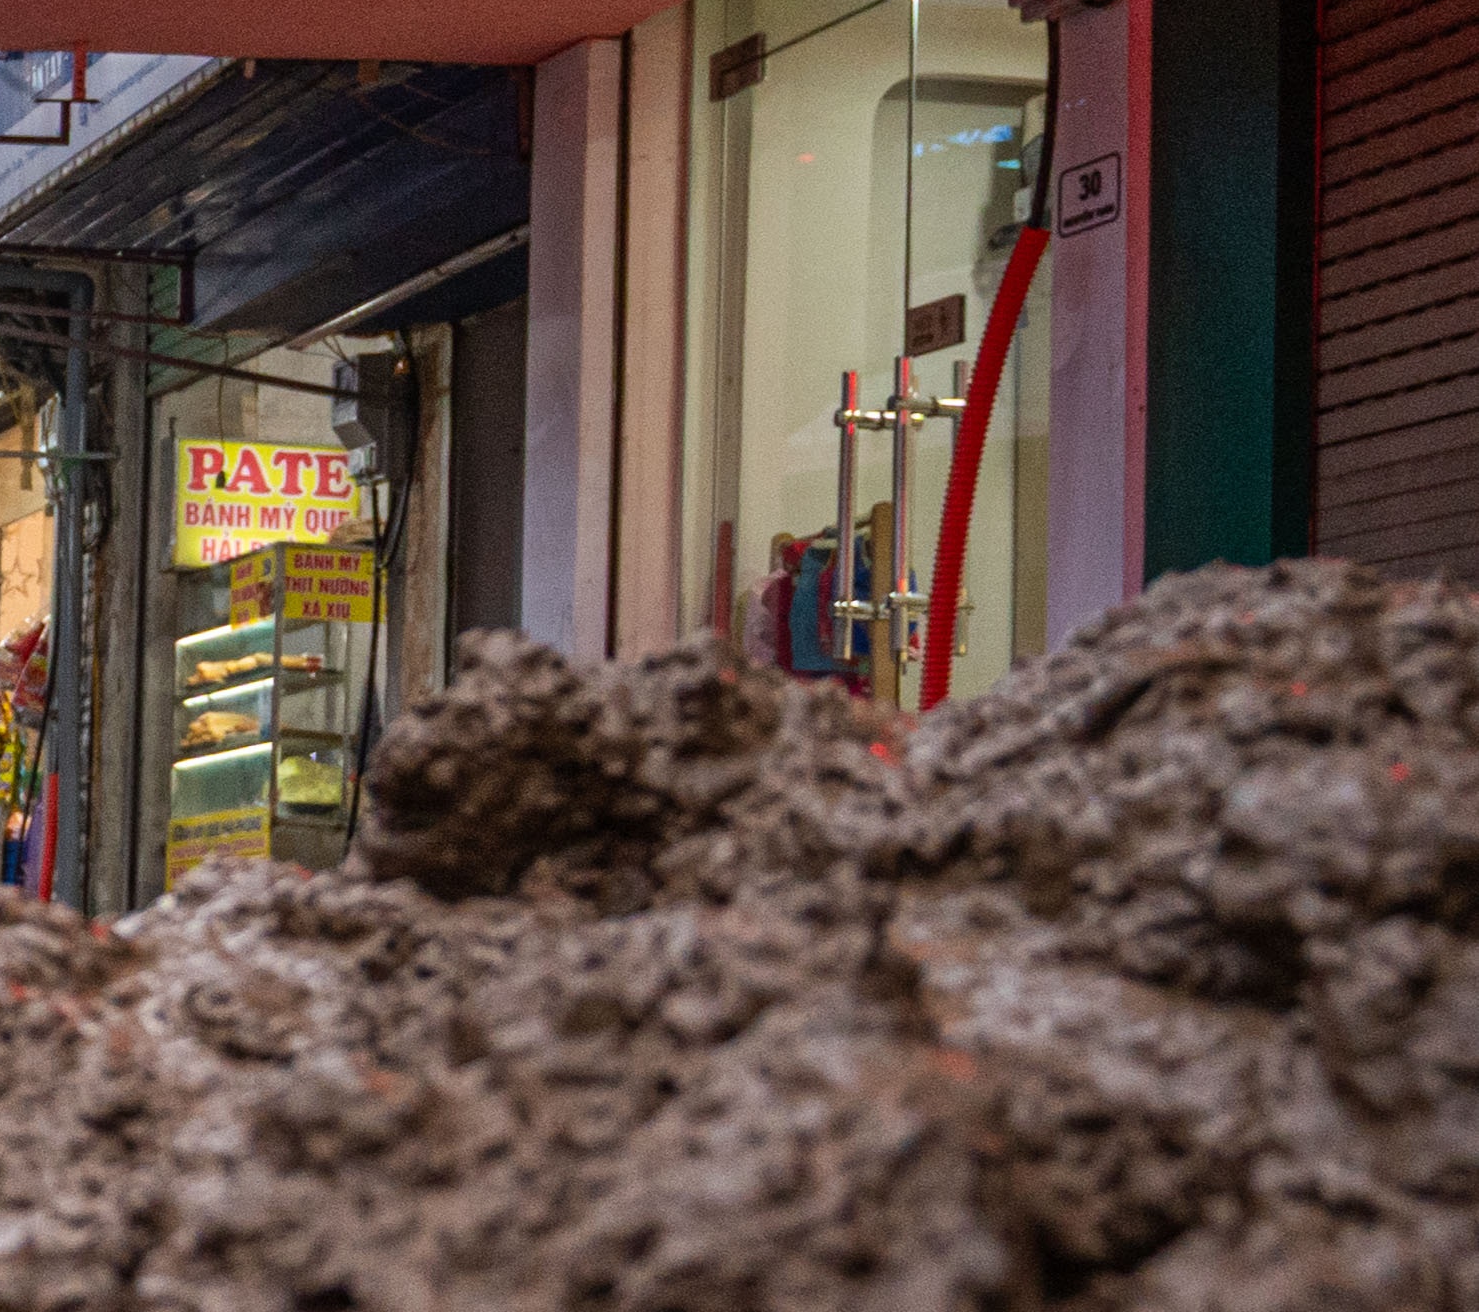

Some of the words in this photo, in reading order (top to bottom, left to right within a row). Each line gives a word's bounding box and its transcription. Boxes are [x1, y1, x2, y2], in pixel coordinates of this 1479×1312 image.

[1079, 170, 1103, 202] 30
[187, 446, 352, 498] PATE
[185, 497, 251, 528] BÁNH
[305, 510, 350, 534] QUE
